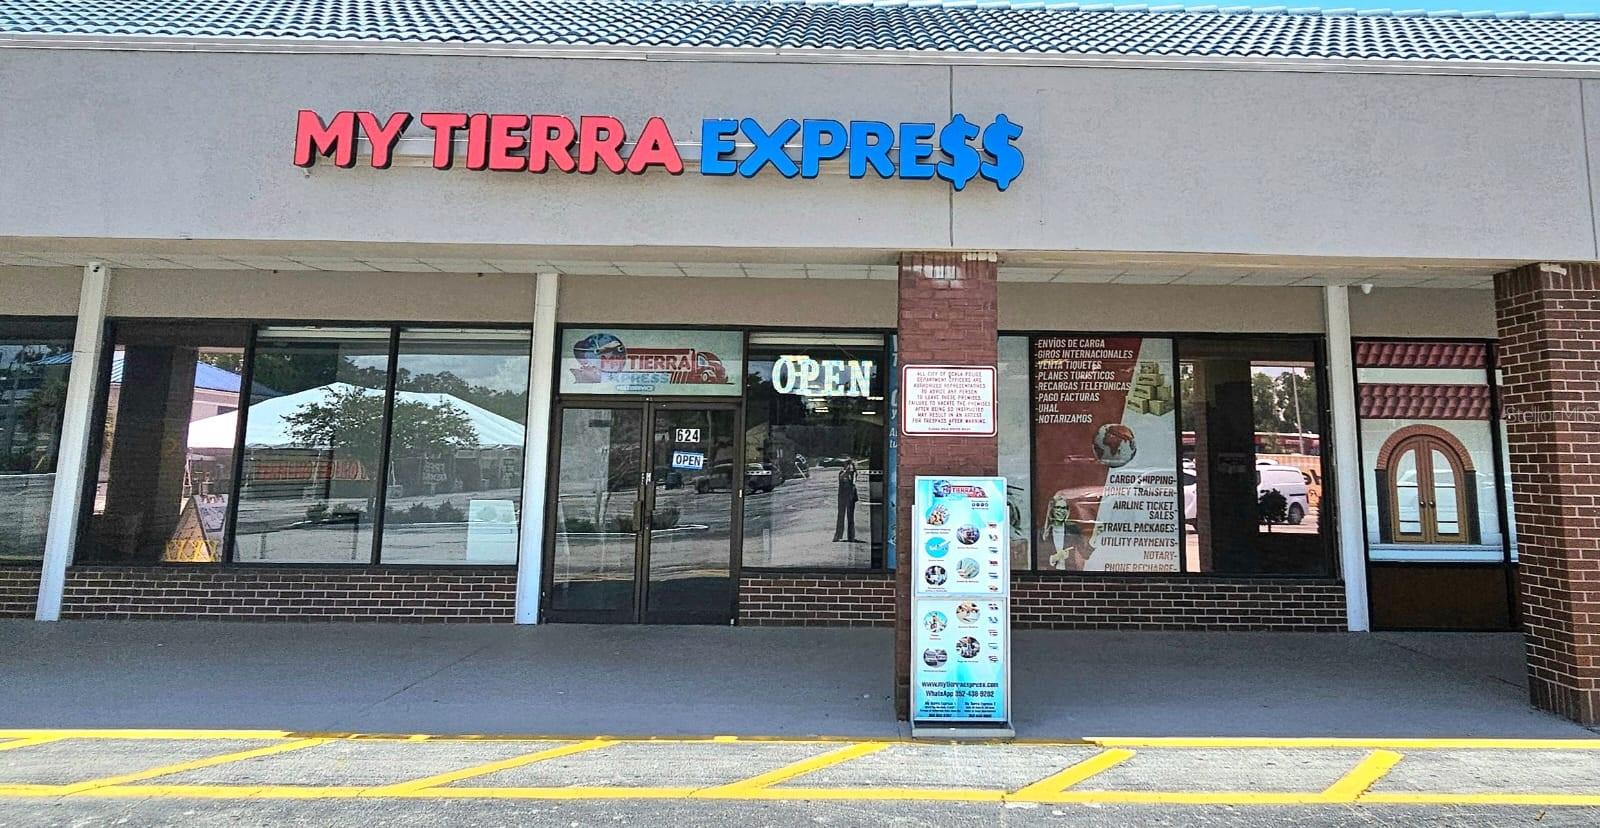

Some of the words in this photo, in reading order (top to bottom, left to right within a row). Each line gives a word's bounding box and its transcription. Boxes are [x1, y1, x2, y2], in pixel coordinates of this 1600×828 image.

[294, 110, 413, 169] MY
[420, 112, 684, 176] TIERRA
[700, 113, 1024, 192] EXPRE$$
[1067, 339, 1078, 348] DE
[1080, 339, 1105, 348] CARGA
[1034, 350, 1060, 358] -GIROS
[1062, 350, 1133, 359] INTERNACIONALES
[627, 355, 691, 370] TIERRA
[1066, 361, 1102, 370] TIQUETES
[602, 373, 670, 384] XPRESS
[772, 356, 873, 397] OPEN
[1035, 371, 1068, 380] -PLANES
[1035, 382, 1078, 390] -RECARGAS
[1035, 393, 1059, 402] -PAGO
[1060, 393, 1100, 402] FACTURAS
[1035, 414, 1093, 423] -NOTARIZAMOS
[677, 430, 698, 442] 624
[676, 454, 701, 466] OPEN
[1110, 475, 1136, 484] CARGO
[1113, 501, 1144, 510] AIRLINE
[1147, 502, 1174, 510] TICKET
[1103, 523, 1132, 532] TRAVEL
[1101, 537, 1132, 546] UTILITY
